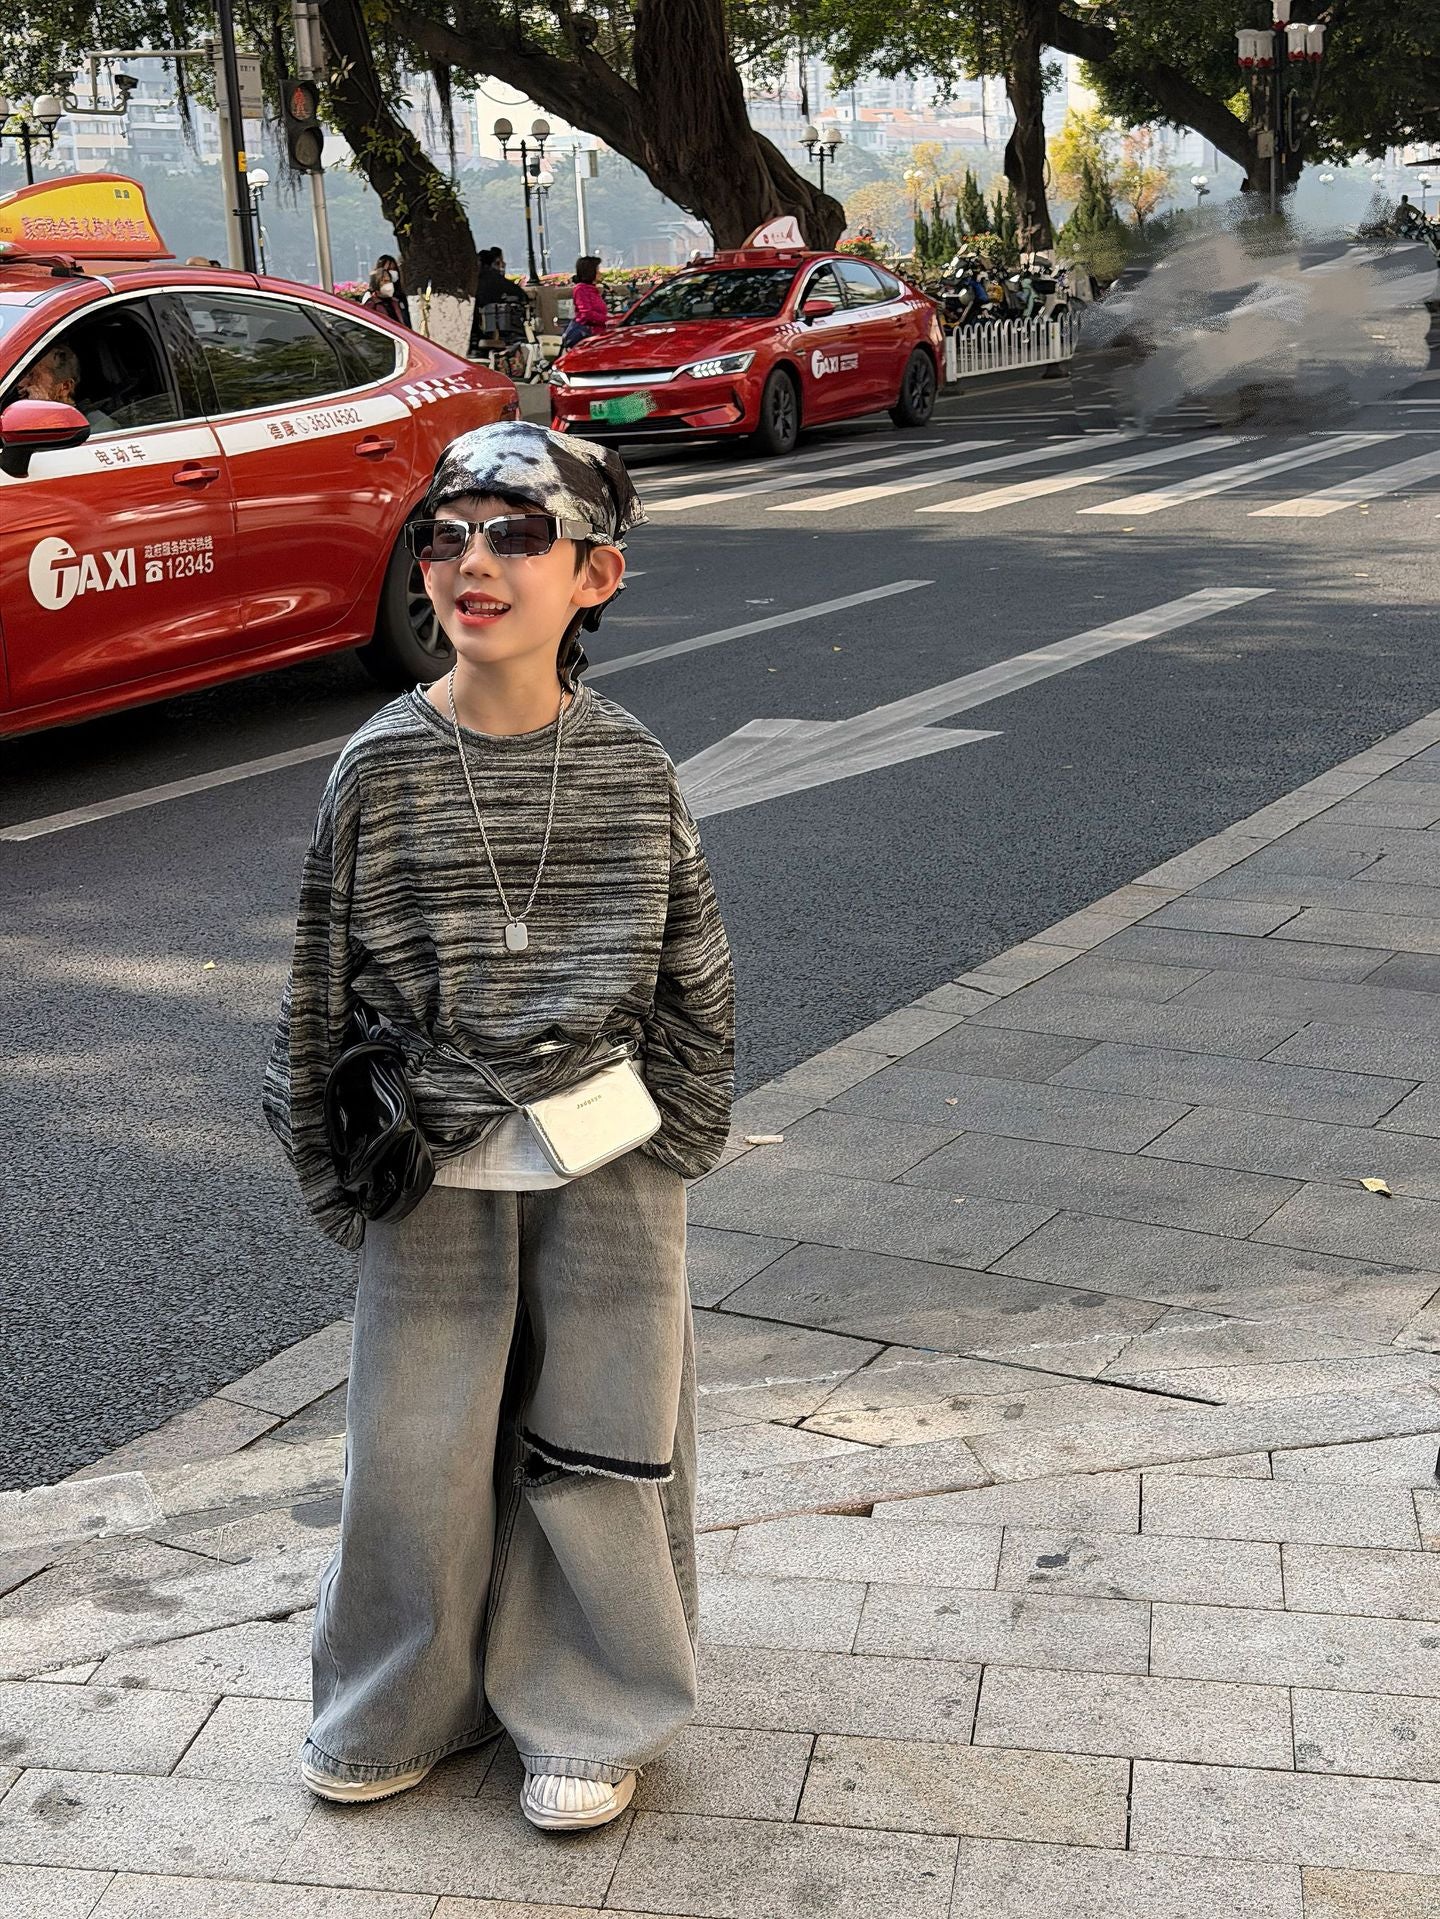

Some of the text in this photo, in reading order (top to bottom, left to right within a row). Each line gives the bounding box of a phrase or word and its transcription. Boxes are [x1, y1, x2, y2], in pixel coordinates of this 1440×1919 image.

[309, 407, 363, 431] 36314582
[94, 443, 146, 467] 电动车
[29, 537, 136, 610] TAXI
[166, 552, 214, 579] 12345
